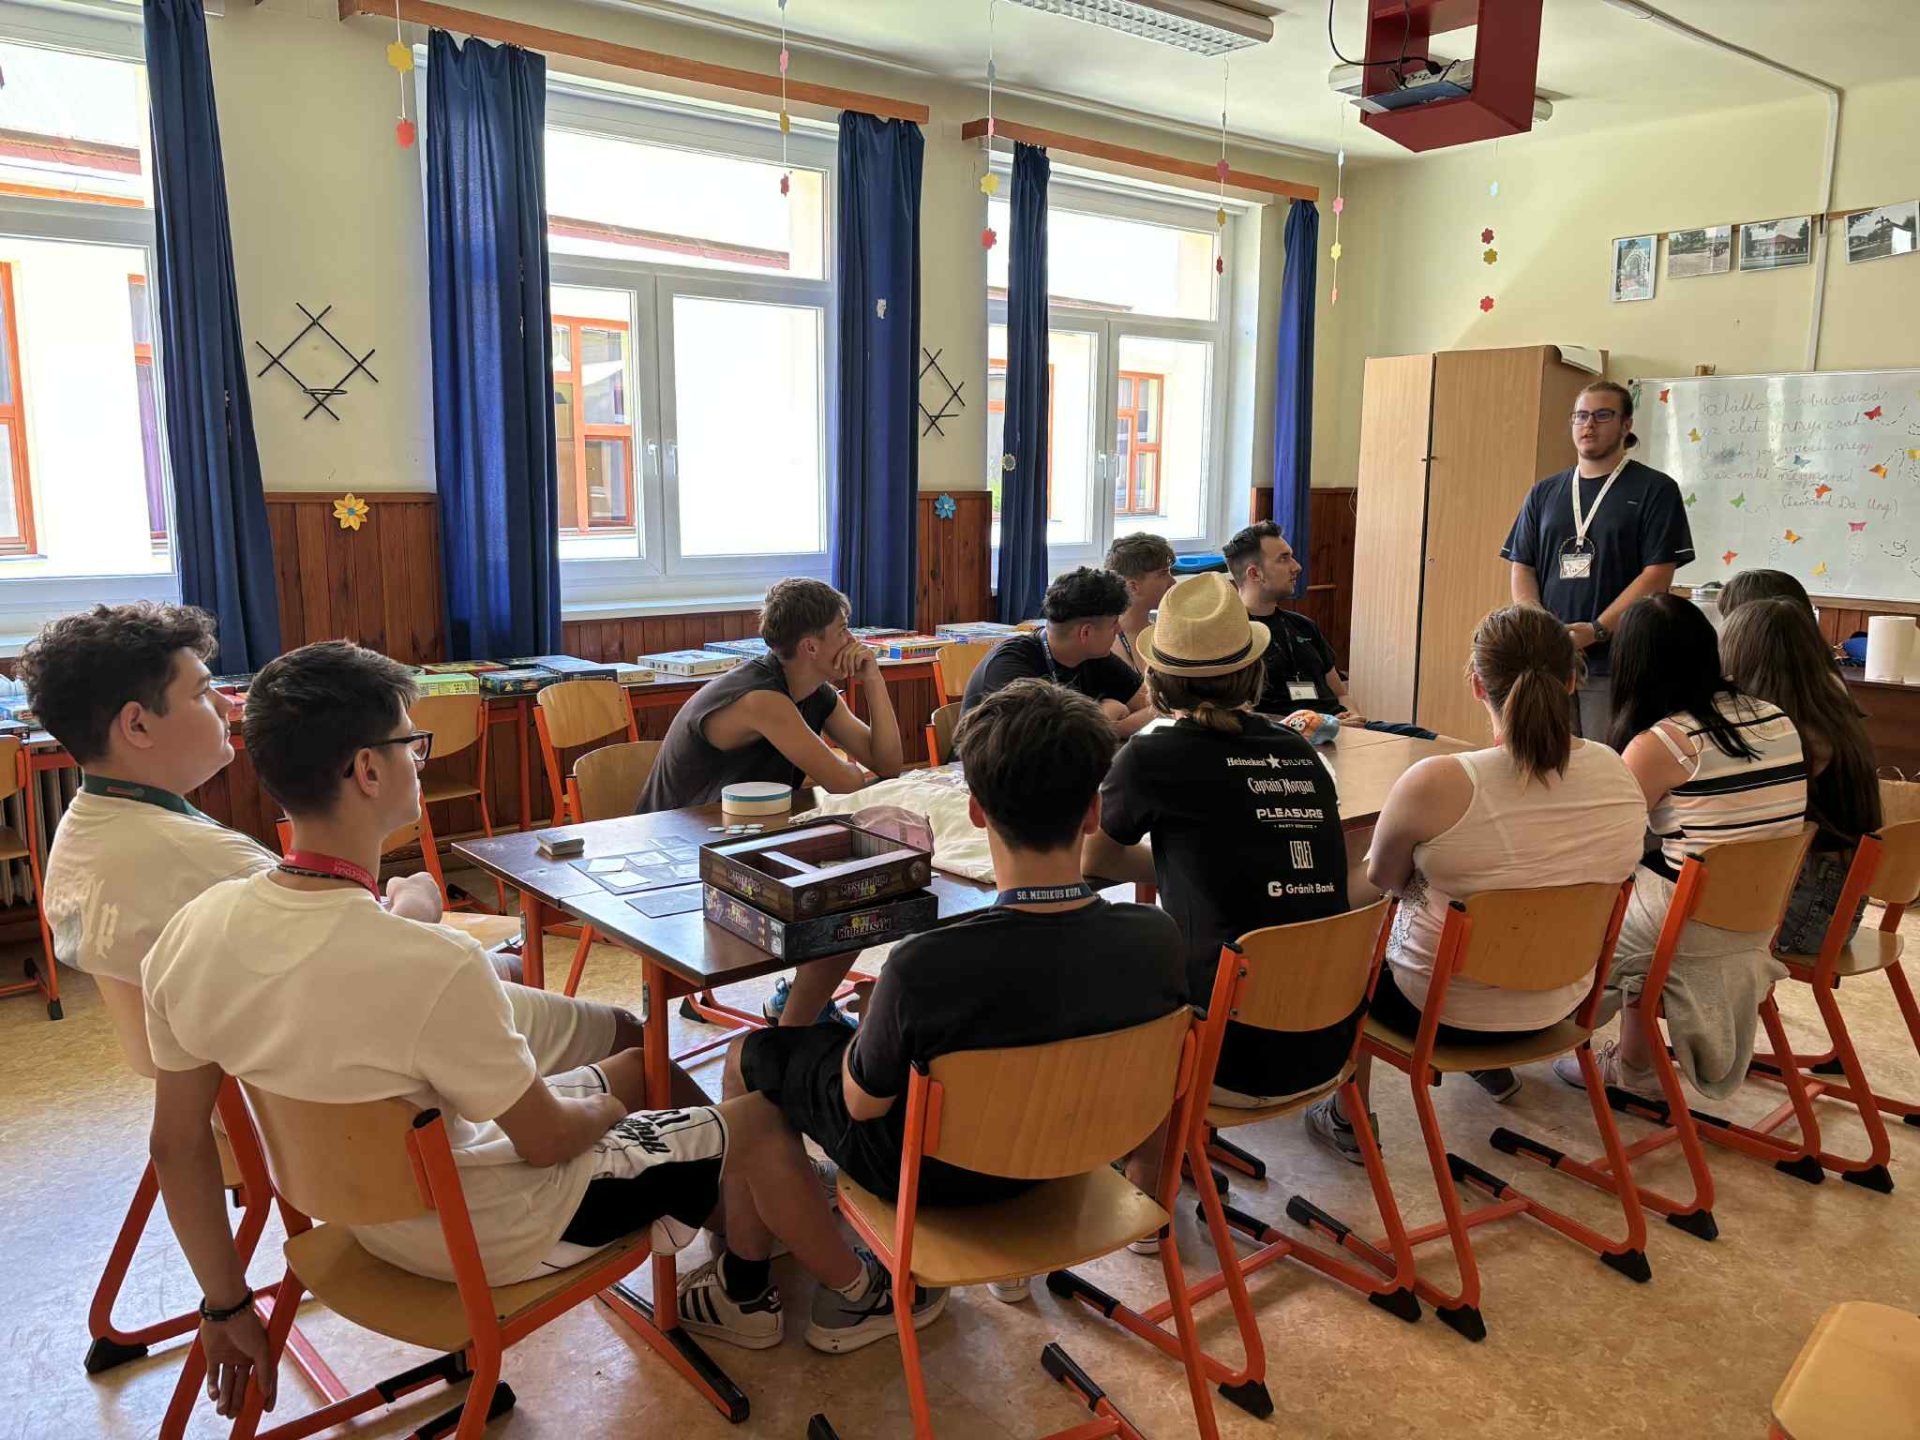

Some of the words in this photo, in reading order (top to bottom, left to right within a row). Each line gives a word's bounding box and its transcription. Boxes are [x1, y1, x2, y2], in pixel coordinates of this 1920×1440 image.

[1226, 757, 1267, 767] Heineken
[1247, 777, 1284, 795] Captain
[1280, 779, 1317, 797] Morgan
[1256, 807, 1324, 820] PLEASURE
[1030, 889, 1065, 900] MEDIKUS
[1065, 887, 1082, 898] KUPA
[1286, 882, 1315, 895] Gránit
[1315, 882, 1335, 893] Bank
